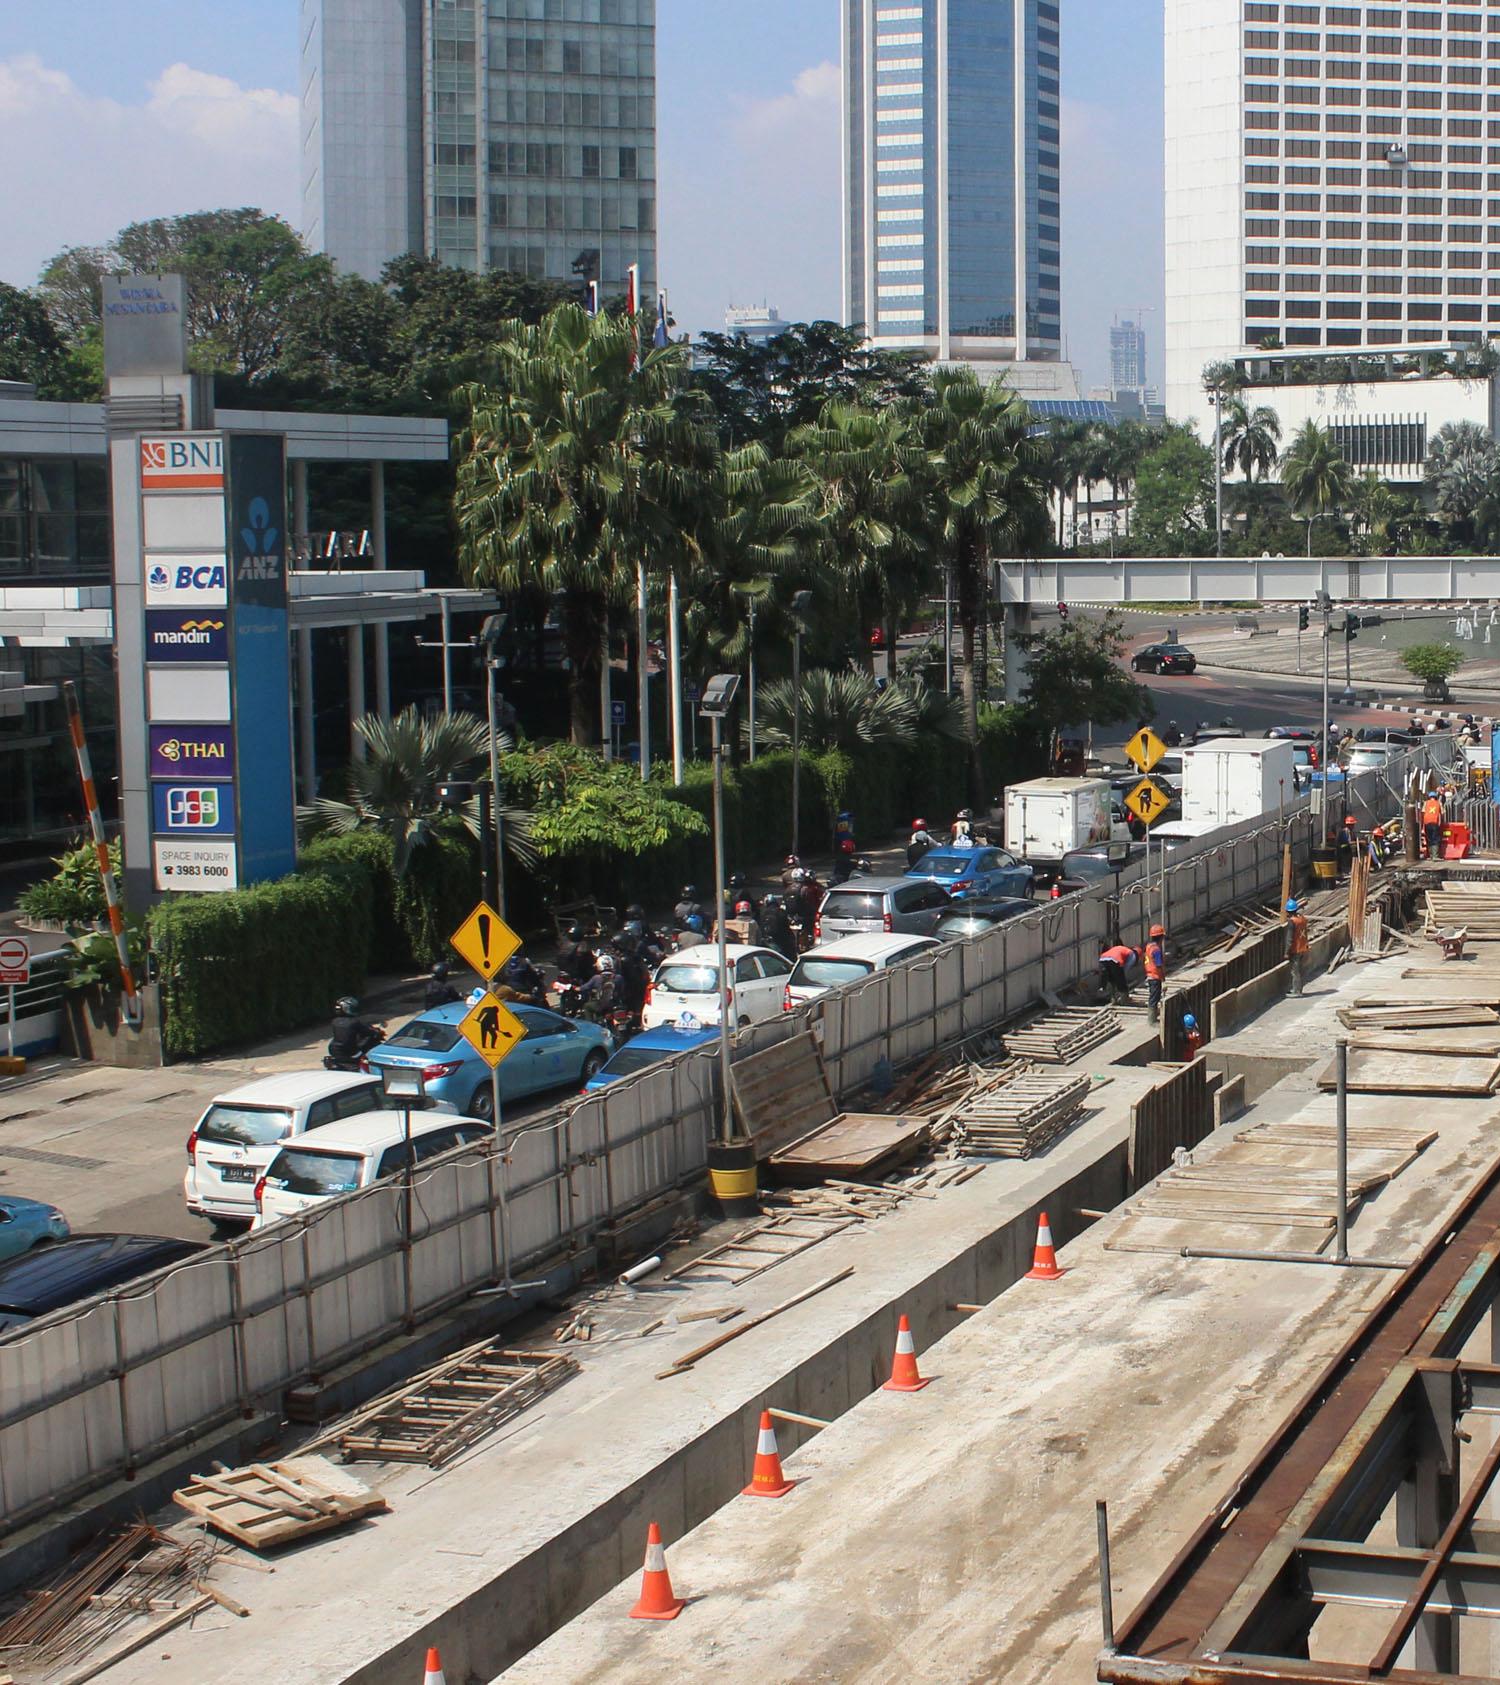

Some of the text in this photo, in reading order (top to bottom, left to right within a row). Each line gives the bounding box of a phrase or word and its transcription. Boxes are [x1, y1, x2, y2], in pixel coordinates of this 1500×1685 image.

[170, 441, 223, 468] BNI
[238, 555, 279, 580] ANZ
[175, 566, 225, 589] BCA
[154, 629, 210, 645] mandiri
[181, 742, 225, 758] THAI
[170, 801, 215, 813] JCB
[162, 851, 229, 861] SPACE INQUIRY
[177, 866, 229, 877] 3983 6000
